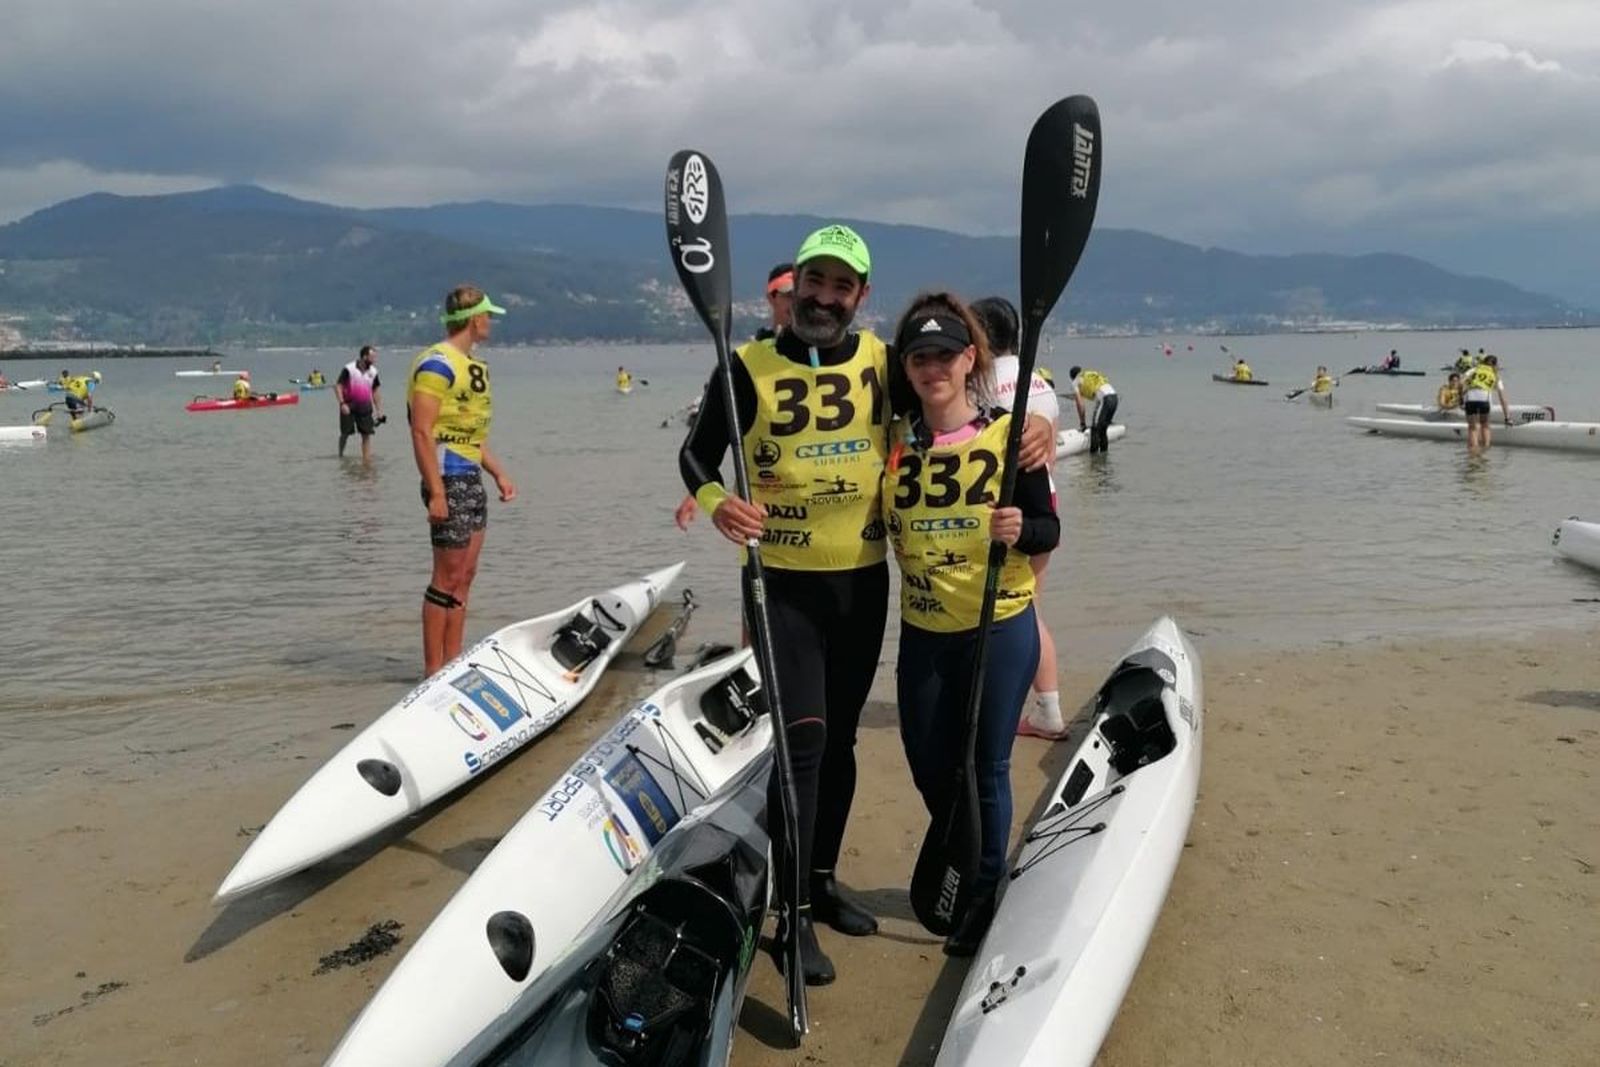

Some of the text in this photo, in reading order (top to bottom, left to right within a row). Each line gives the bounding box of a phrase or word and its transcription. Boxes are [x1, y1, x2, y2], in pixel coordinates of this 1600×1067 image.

[770, 366, 883, 436] 331
[797, 440, 870, 458] NELO
[894, 449, 998, 509] 332
[912, 518, 979, 531] NELO
